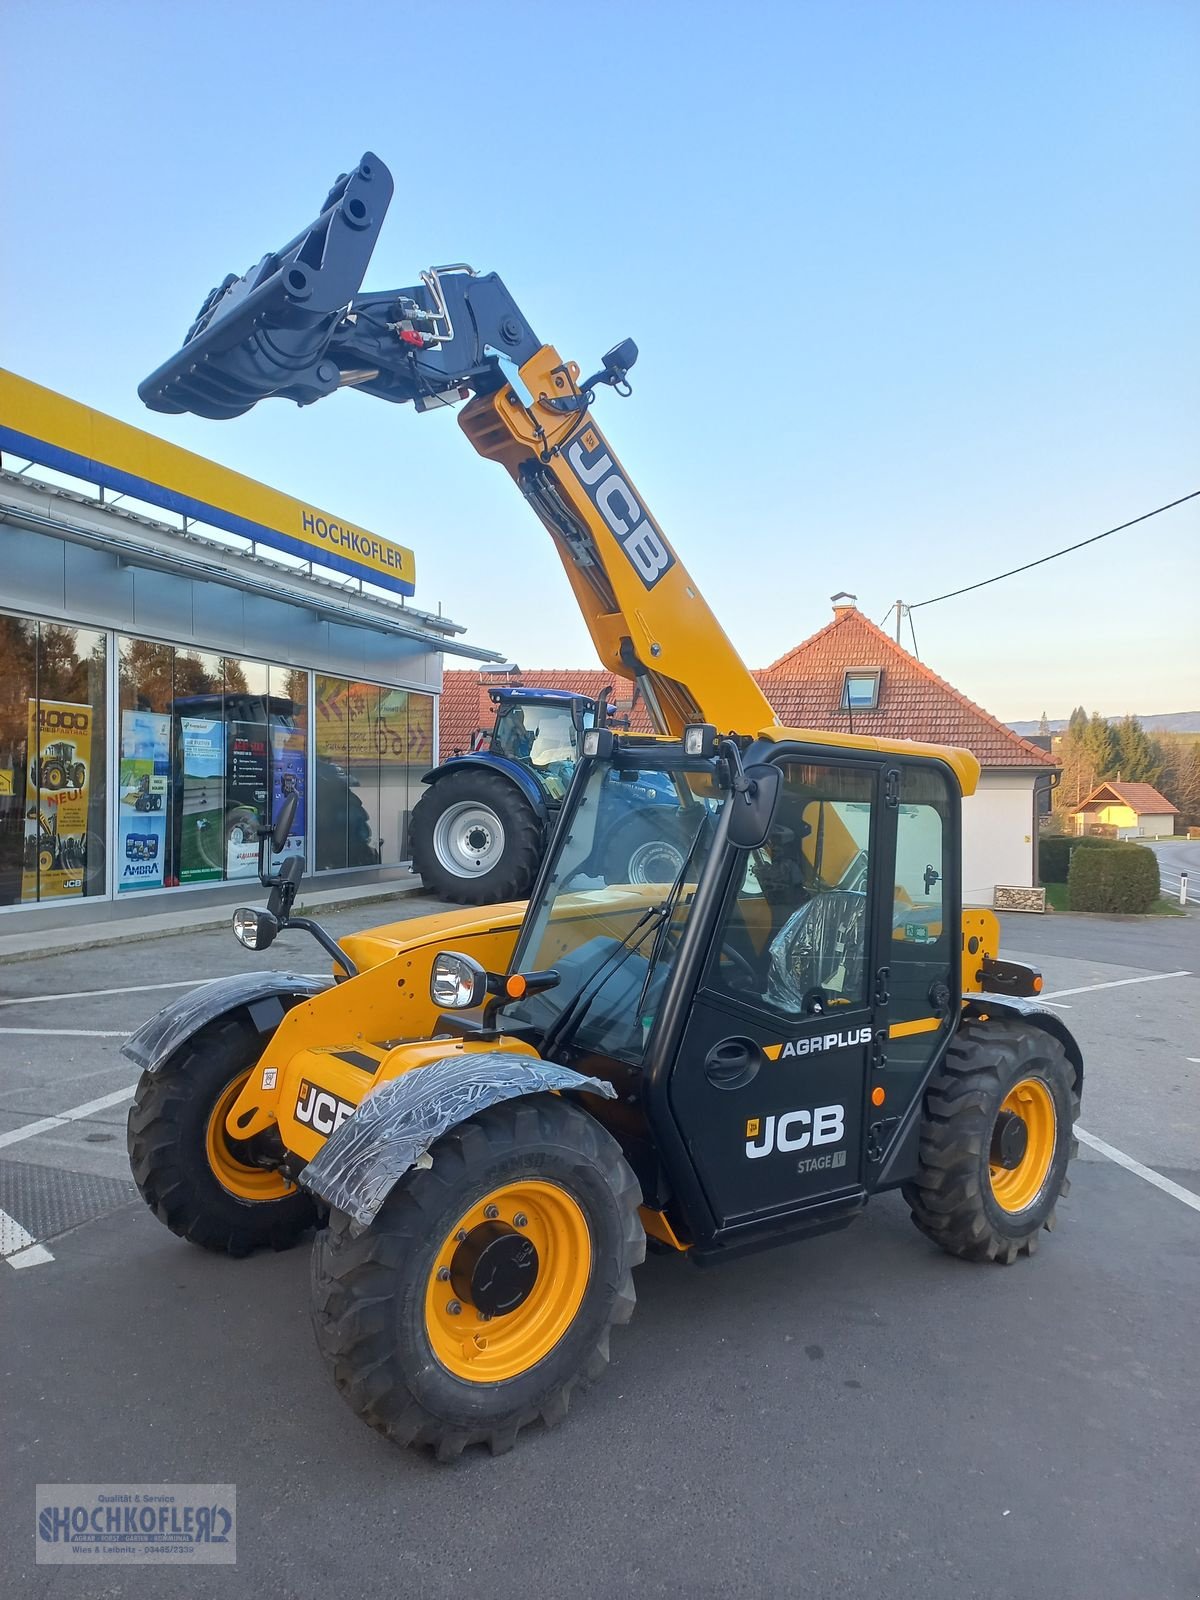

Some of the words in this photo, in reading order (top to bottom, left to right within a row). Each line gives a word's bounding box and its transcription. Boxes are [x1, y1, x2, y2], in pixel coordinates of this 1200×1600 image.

[568, 440, 670, 583] JCB
[301, 510, 403, 570] HOCHKOFLER
[32, 709, 89, 730] 4000
[47, 788, 83, 808] NEU!
[123, 862, 159, 876] AMBRA
[63, 879, 82, 889] JCB
[781, 1027, 872, 1059] AGRIPLUS
[745, 1104, 845, 1159] JCB
[798, 1153, 832, 1174] STAGE
